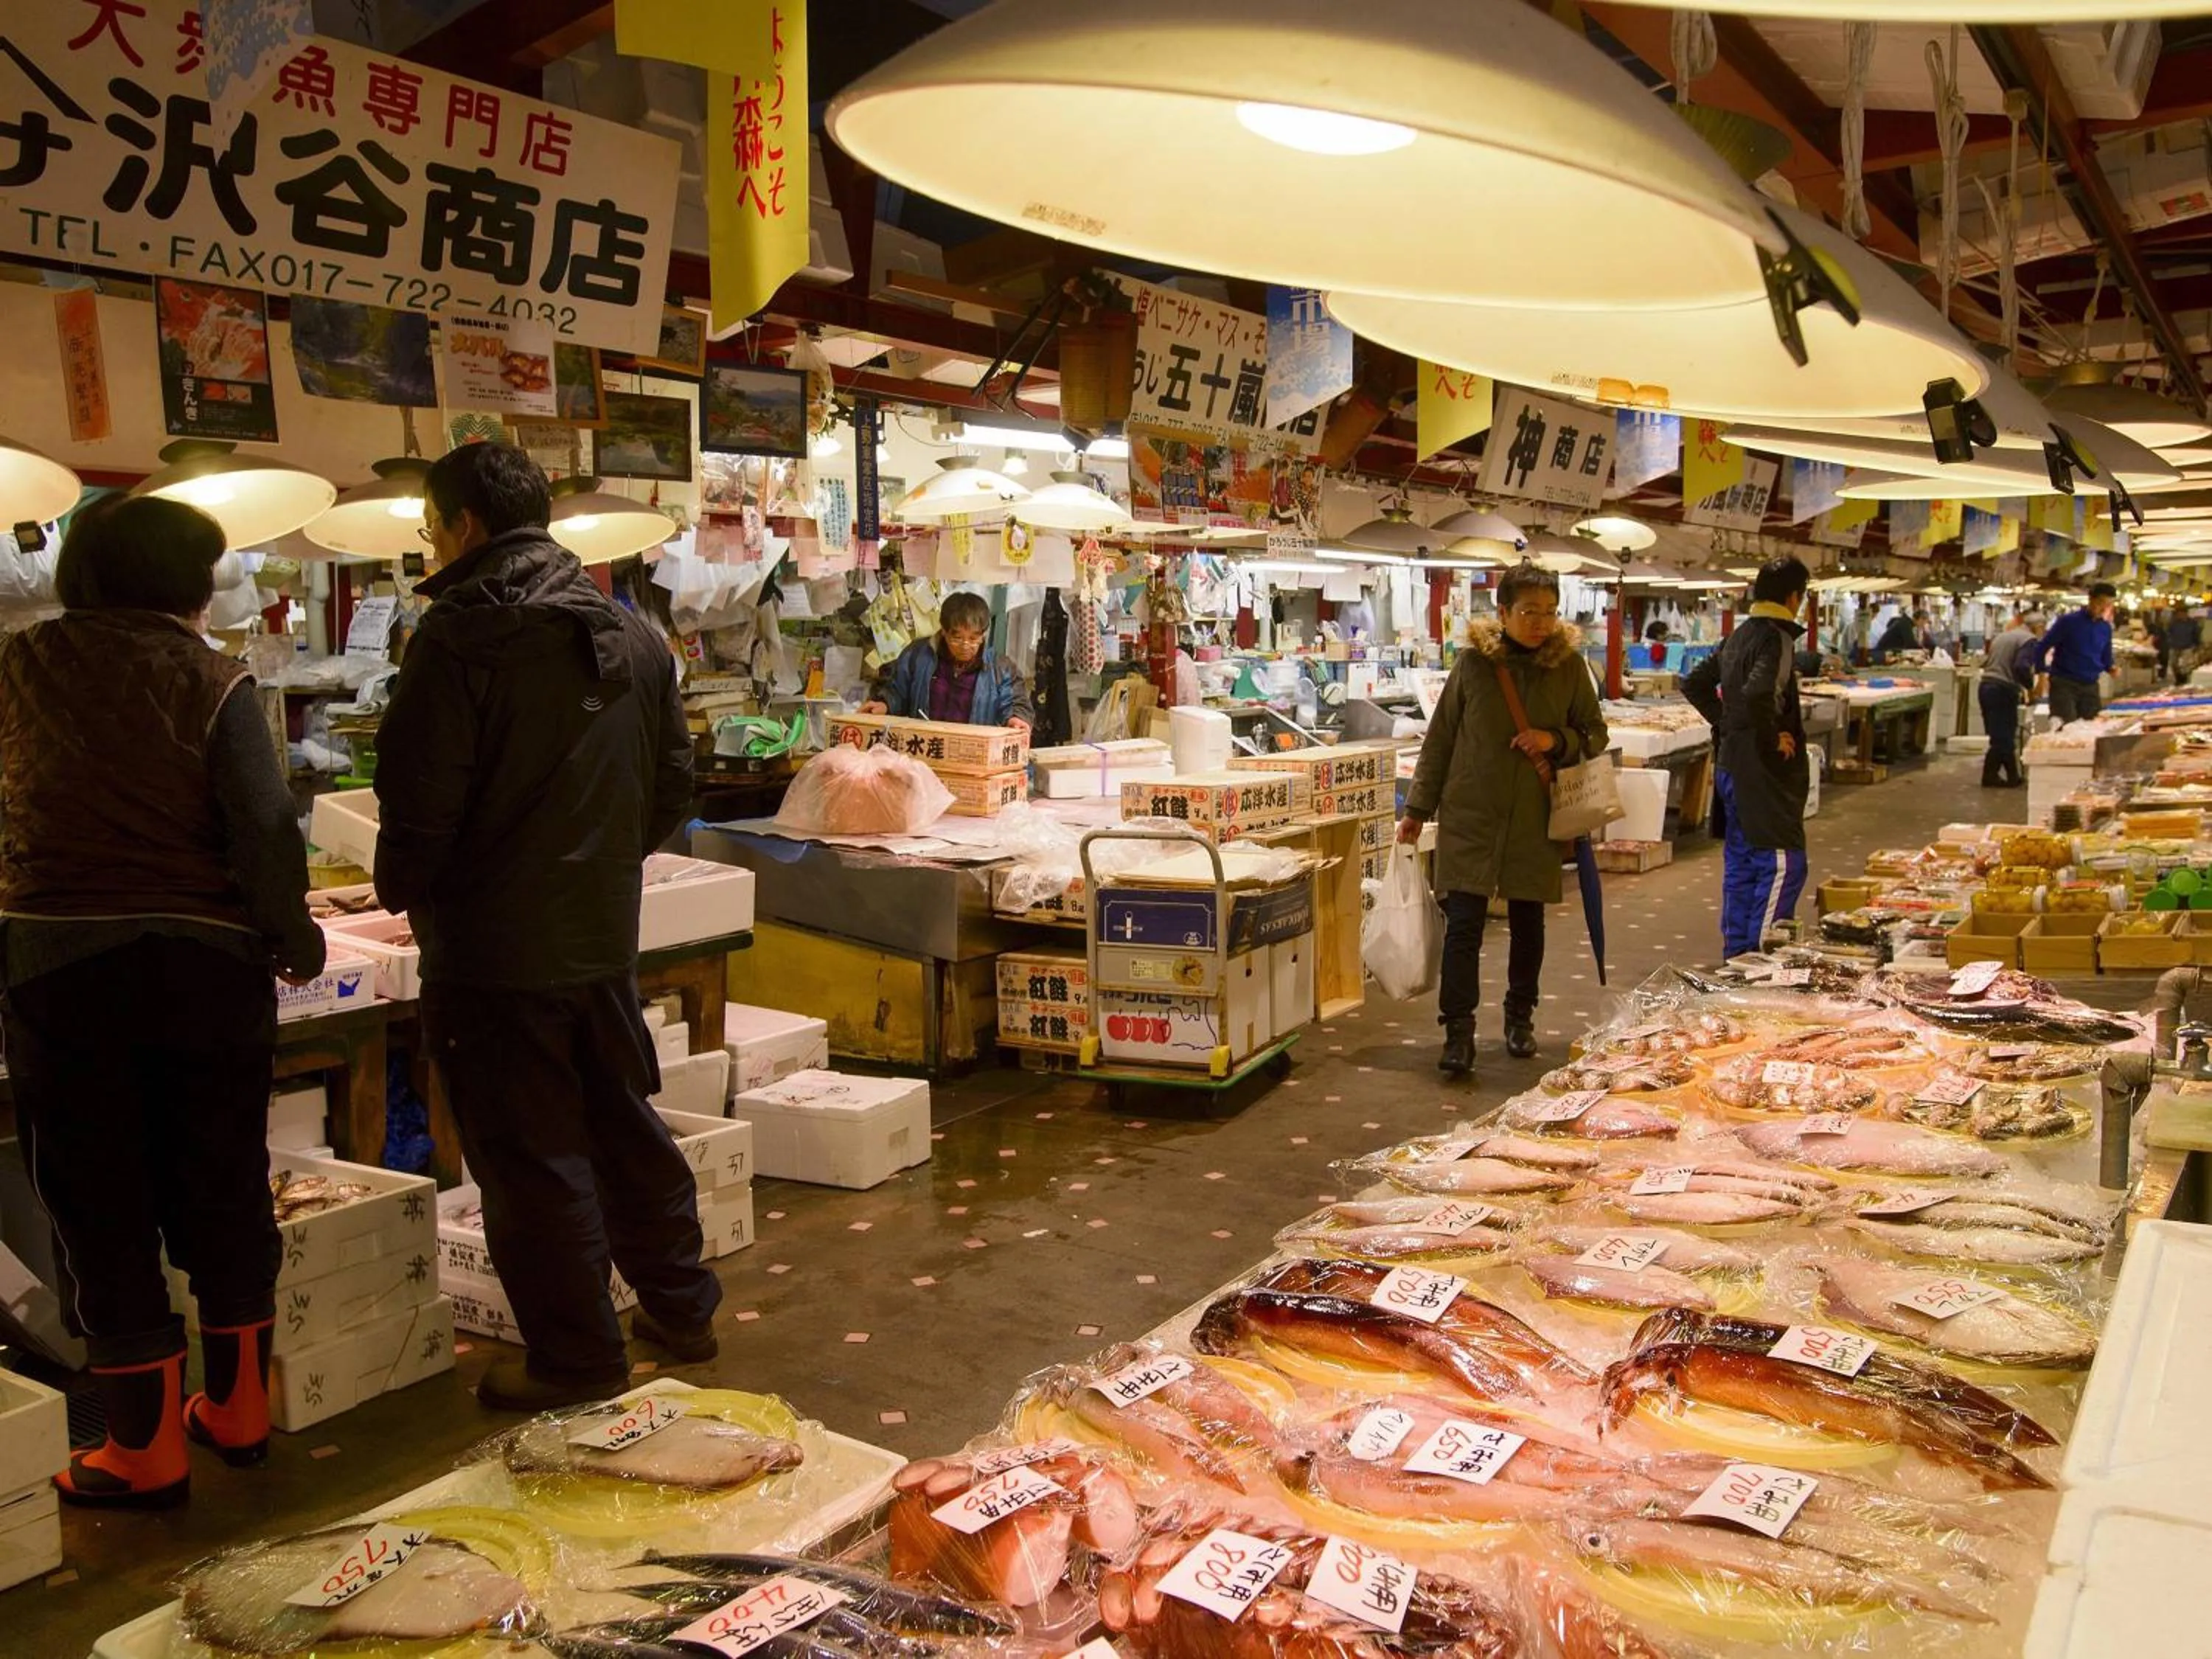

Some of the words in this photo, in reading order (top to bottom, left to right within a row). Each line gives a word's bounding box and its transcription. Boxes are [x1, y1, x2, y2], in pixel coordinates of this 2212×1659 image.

[1505, 405, 1606, 488] 神商店
[1151, 795, 1189, 820] 紅鮭
[1028, 975, 1068, 1001] 紅鮭
[1029, 1014, 1068, 1039] 紅鮭
[1388, 1268, 1427, 1305] 500
[1801, 1328, 1833, 1359] 500
[608, 1399, 655, 1437] 600
[1433, 1426, 1473, 1461] 650
[964, 1474, 1020, 1512] 750
[1723, 1473, 1762, 1506] 700
[321, 1540, 389, 1594] 750
[1194, 1543, 1246, 1592] 800
[1219, 1548, 1292, 1602] さしみ用
[1362, 1559, 1405, 1615] しみ用
[709, 1585, 787, 1634] 400
